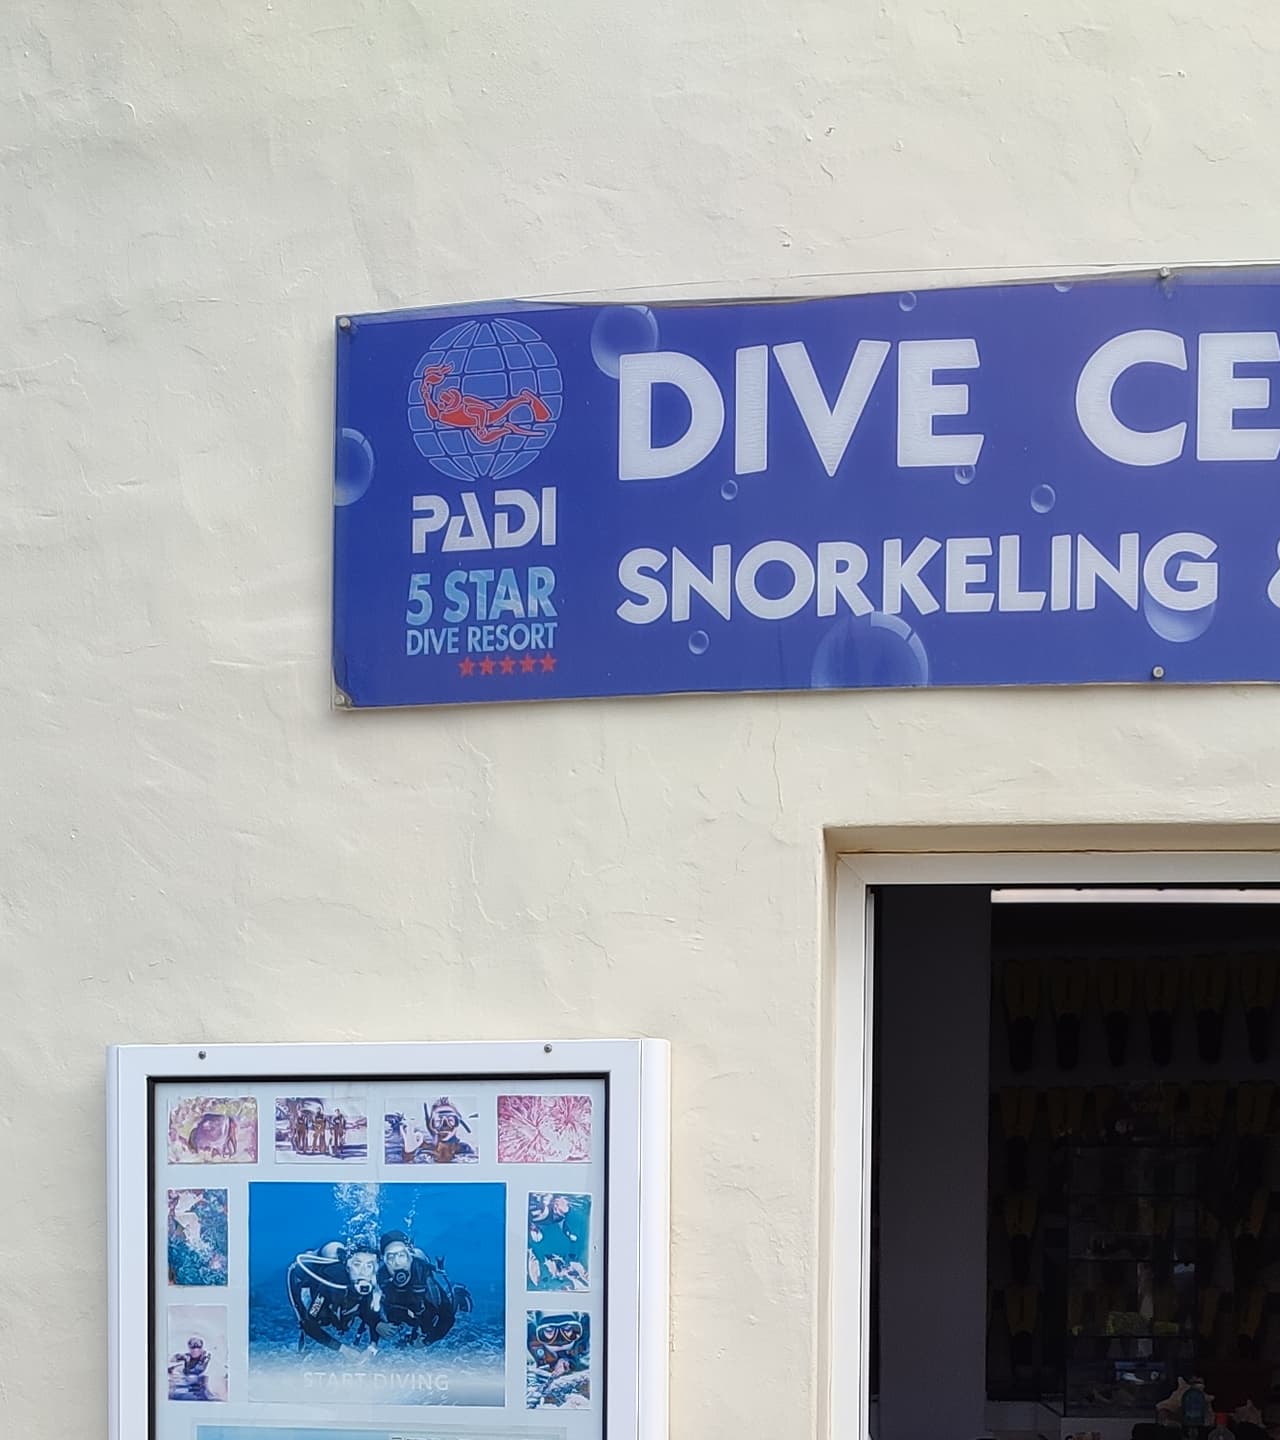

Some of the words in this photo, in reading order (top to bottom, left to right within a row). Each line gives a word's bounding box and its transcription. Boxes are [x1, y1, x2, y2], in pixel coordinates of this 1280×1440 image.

[618, 338, 984, 481] DIVE
[412, 487, 557, 554] PADI
[406, 573, 433, 626] 5
[443, 566, 558, 623] STAR
[615, 532, 1219, 624] SNORKELING
[406, 627, 459, 656] DIVE
[467, 622, 558, 653] RESORT
[303, 1371, 367, 1390] START
[373, 1372, 449, 1391] DIVING
